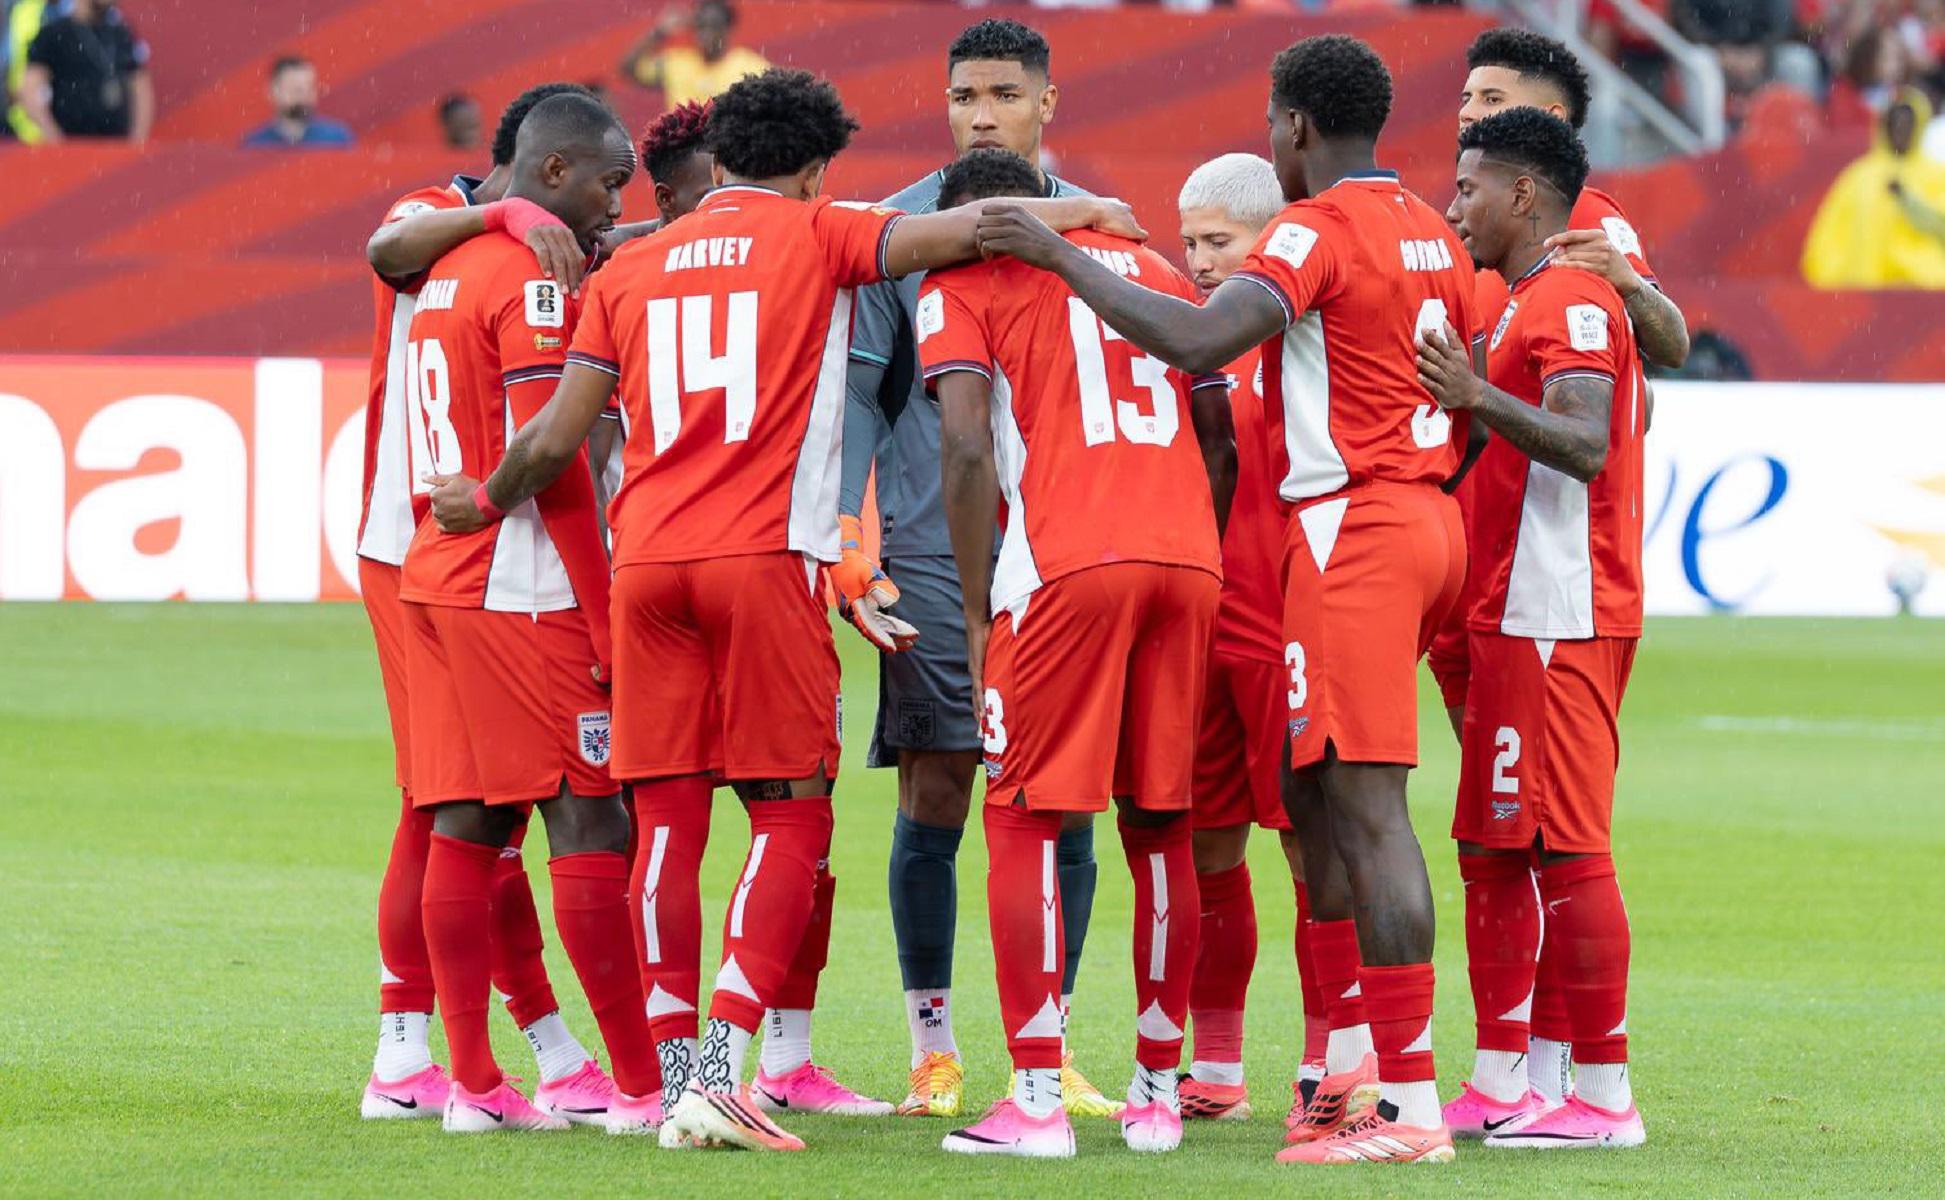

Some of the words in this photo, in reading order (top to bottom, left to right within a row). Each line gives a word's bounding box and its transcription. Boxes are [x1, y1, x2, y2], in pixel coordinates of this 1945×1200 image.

[664, 237, 753, 273] HARVEY
[647, 291, 758, 457] 14
[1067, 296, 1179, 448] 13
[407, 338, 463, 495] 18
[0, 357, 368, 602] al
[1285, 641, 1307, 710] 3
[983, 687, 1008, 754] 3
[1492, 726, 1521, 794] 2
[925, 1018, 943, 1028] OM
